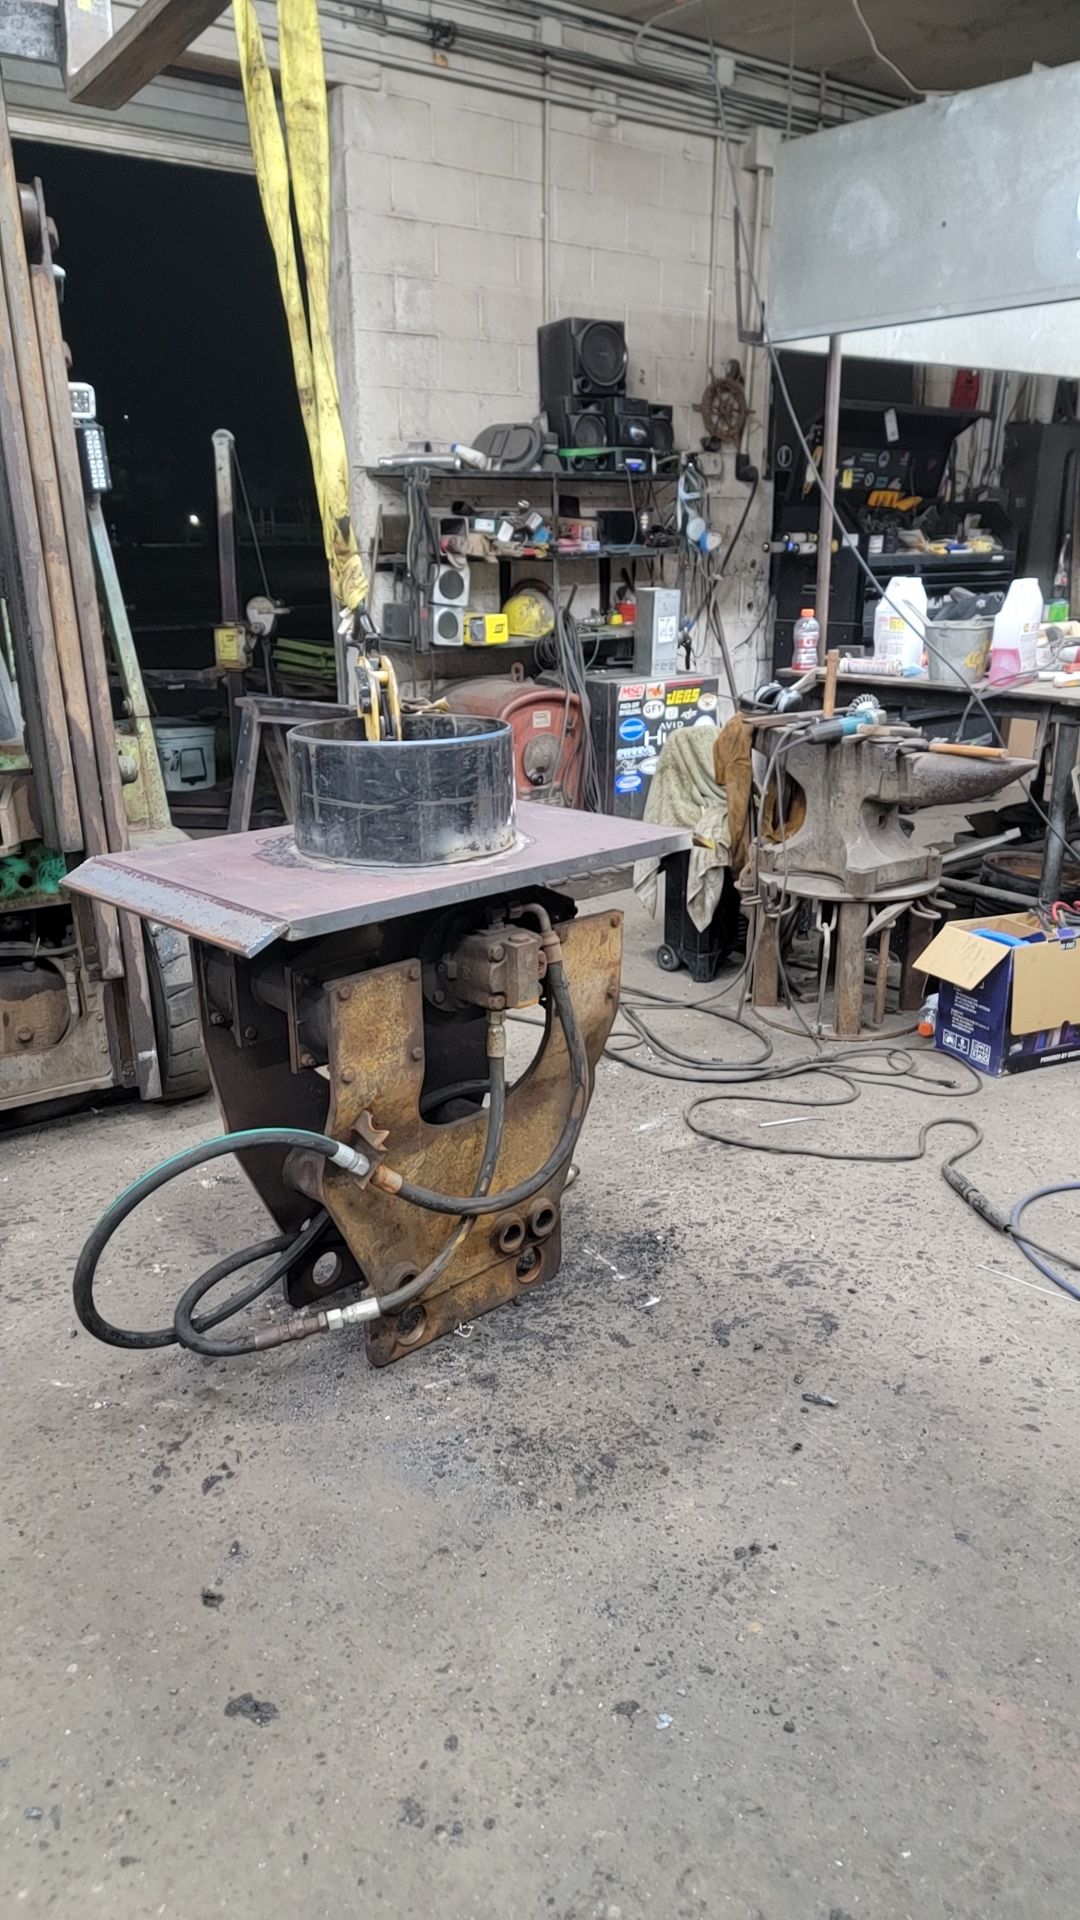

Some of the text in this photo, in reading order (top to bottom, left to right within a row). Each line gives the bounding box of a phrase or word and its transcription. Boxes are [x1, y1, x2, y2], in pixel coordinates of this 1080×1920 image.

[666, 688, 700, 705] JEGS
[645, 703, 662, 714] GFY
[659, 721, 684, 730] AVID
